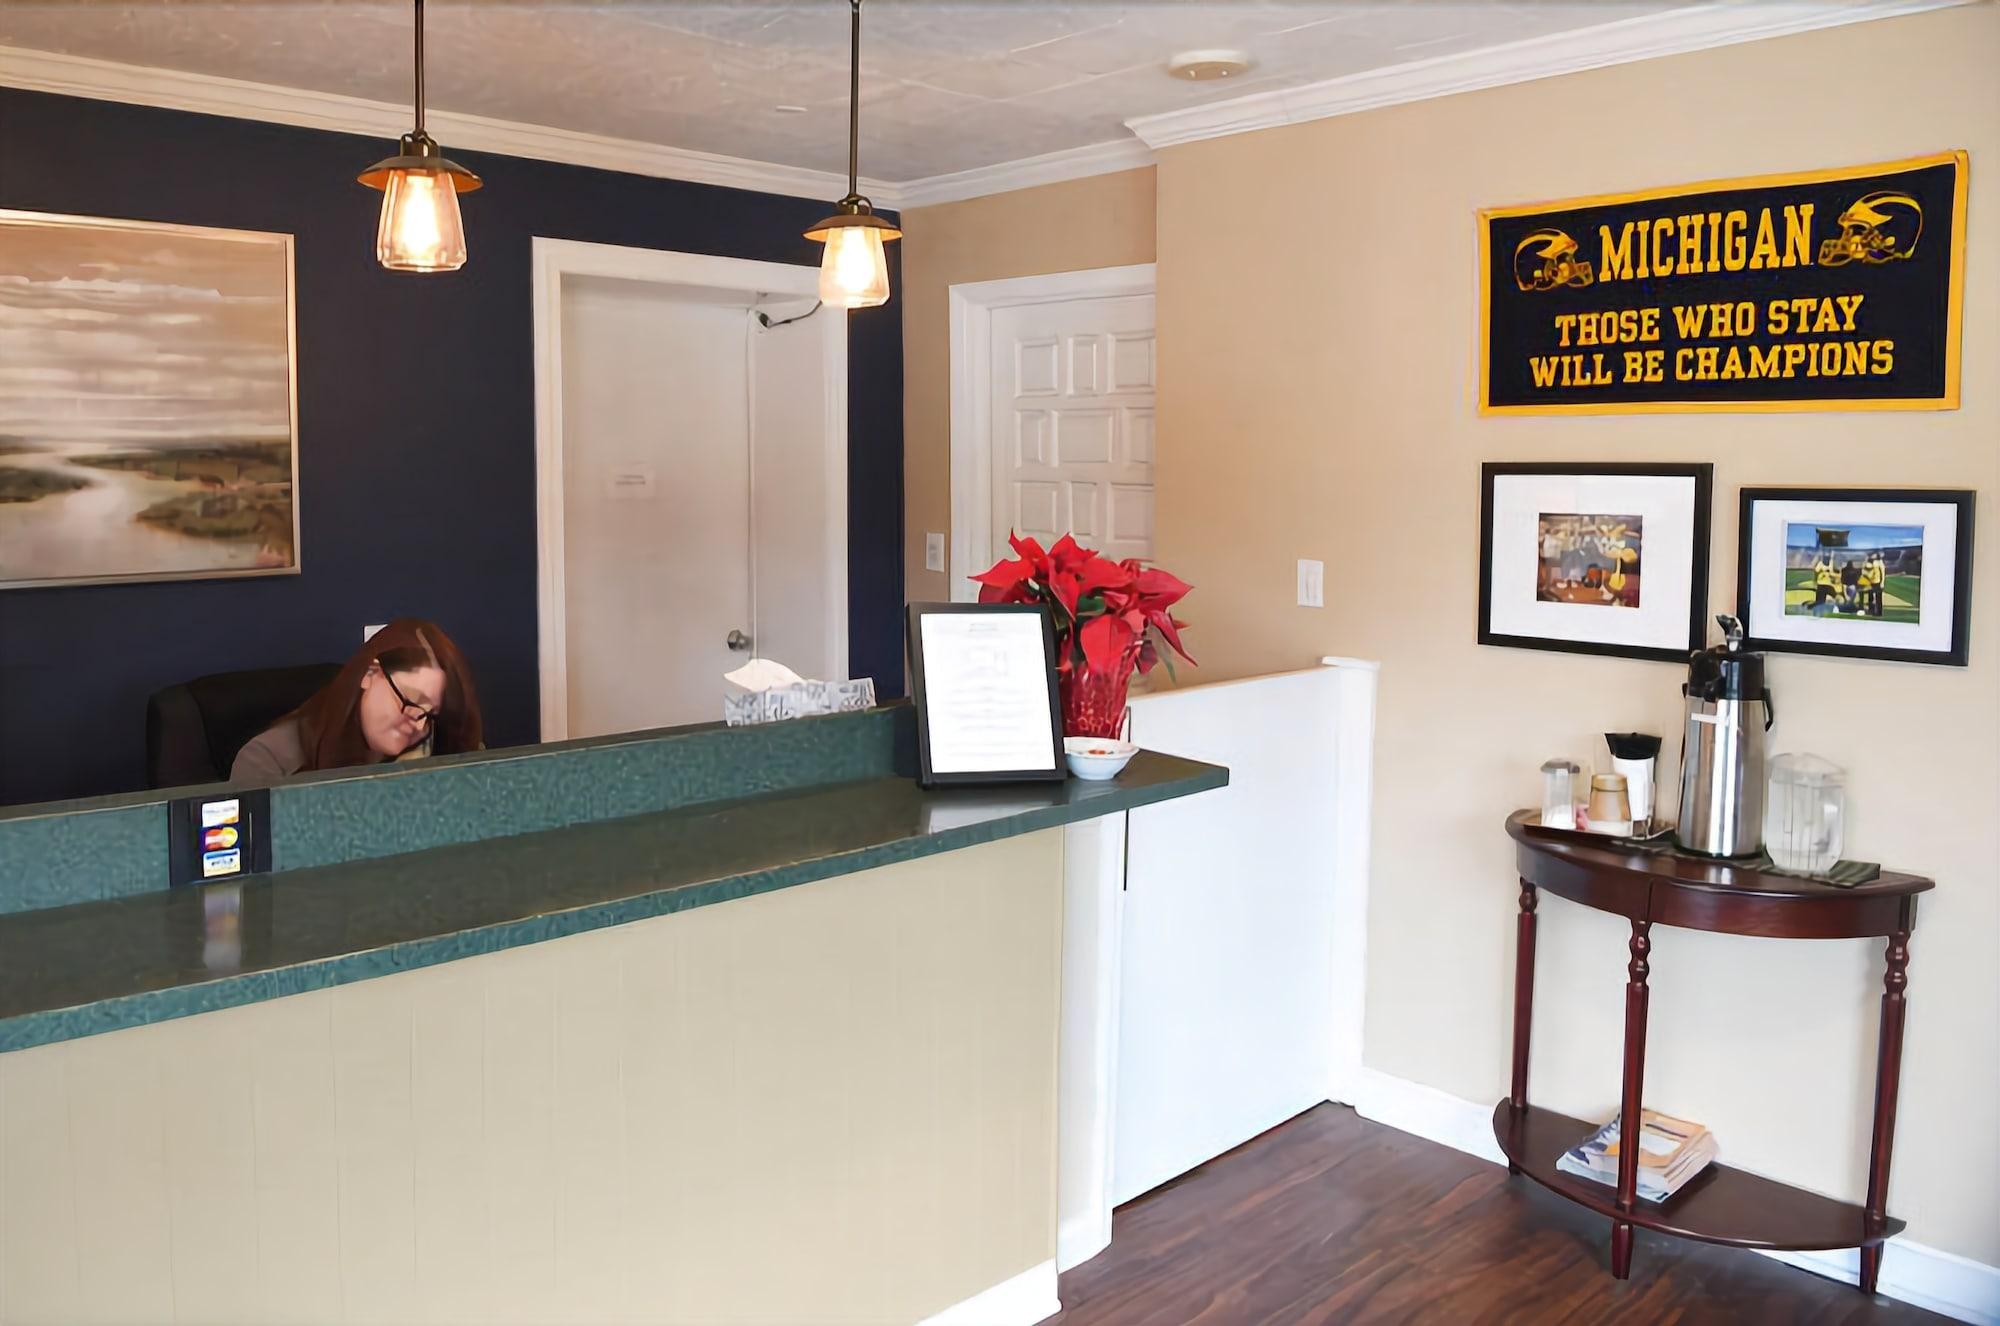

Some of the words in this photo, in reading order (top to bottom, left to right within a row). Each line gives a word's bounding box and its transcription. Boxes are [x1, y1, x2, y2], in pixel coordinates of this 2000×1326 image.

[1599, 203, 1814, 283] MICHIGAN
[1555, 308, 1660, 347] THOSE
[1672, 301, 1755, 339] WHO
[1767, 294, 1864, 335] STAY
[1529, 354, 1612, 388] WILL
[1623, 350, 1664, 382] BE
[1675, 340, 1894, 381] CHAMPIONS
